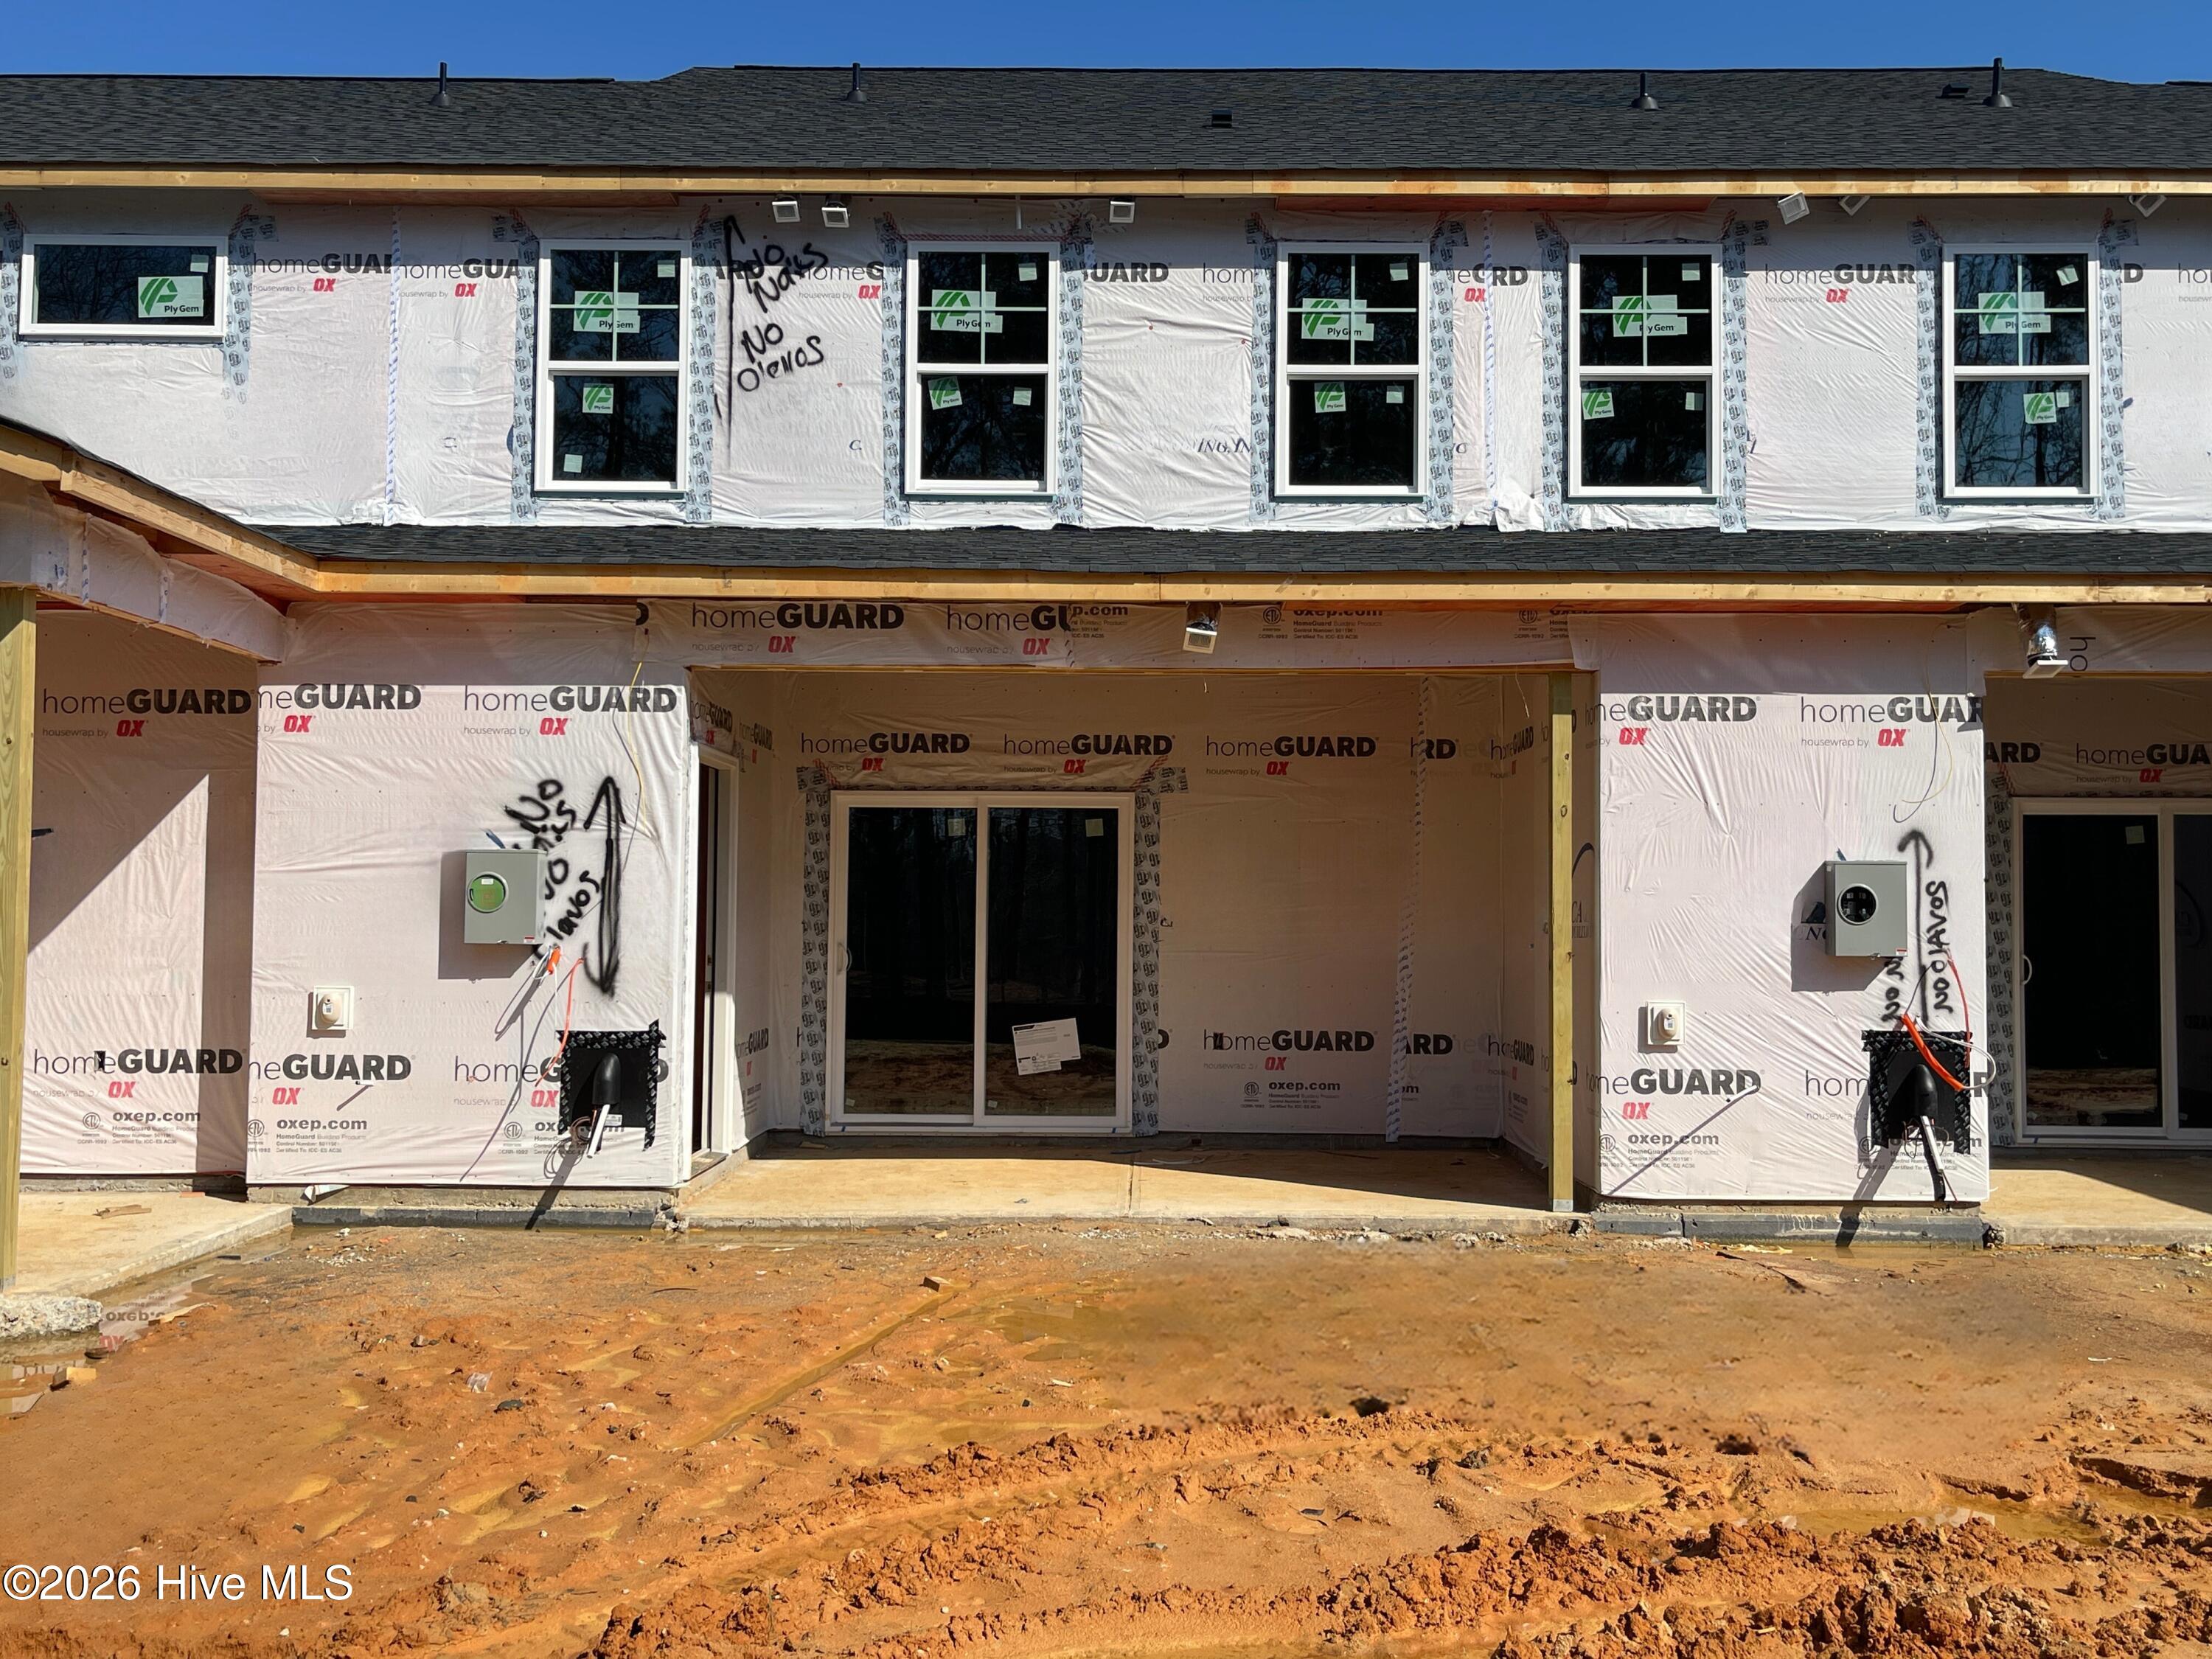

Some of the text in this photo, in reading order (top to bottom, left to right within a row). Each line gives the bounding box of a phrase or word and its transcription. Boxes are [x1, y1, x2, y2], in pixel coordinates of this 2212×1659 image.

[313, 278, 337, 292] OX
[455, 283, 478, 297] OX
[858, 285, 881, 299] OX
[1826, 288, 1849, 303] OX
[164, 305, 199, 315] Ply Gem
[599, 320, 613, 330] Ply
[956, 319, 970, 329] Ply
[1327, 327, 1340, 337] Ply
[692, 602, 904, 629] homeGUARD
[768, 636, 796, 653] OX
[1022, 638, 1051, 655] OX
[42, 689, 251, 714] homeGUARD
[465, 685, 677, 713] homeGUARD
[42, 720, 145, 738] housewrap by OX
[284, 715, 313, 733] OX
[464, 717, 568, 737] housewrap by OX
[801, 732, 970, 754] homeGUARD
[1619, 728, 1648, 745] OX
[1801, 728, 1906, 748] housewrap by OX
[1004, 734, 1172, 756] homeGUARD
[1206, 735, 1376, 757] homeGUARD
[862, 757, 884, 771] OX
[1063, 759, 1087, 773] OX
[1266, 761, 1289, 776] OX
[2139, 768, 2163, 783] OX
[1265, 1056, 1287, 1071] OX
[108, 1081, 137, 1098] OX
[1268, 1081, 1340, 1092] oxep.com
[271, 1087, 301, 1105] OX
[530, 1090, 559, 1108] OX
[113, 1112, 201, 1124] oxep.com
[1622, 1102, 1651, 1120] OX
[276, 1119, 367, 1131] oxep.com
[1628, 1133, 1719, 1147] oxep.com
